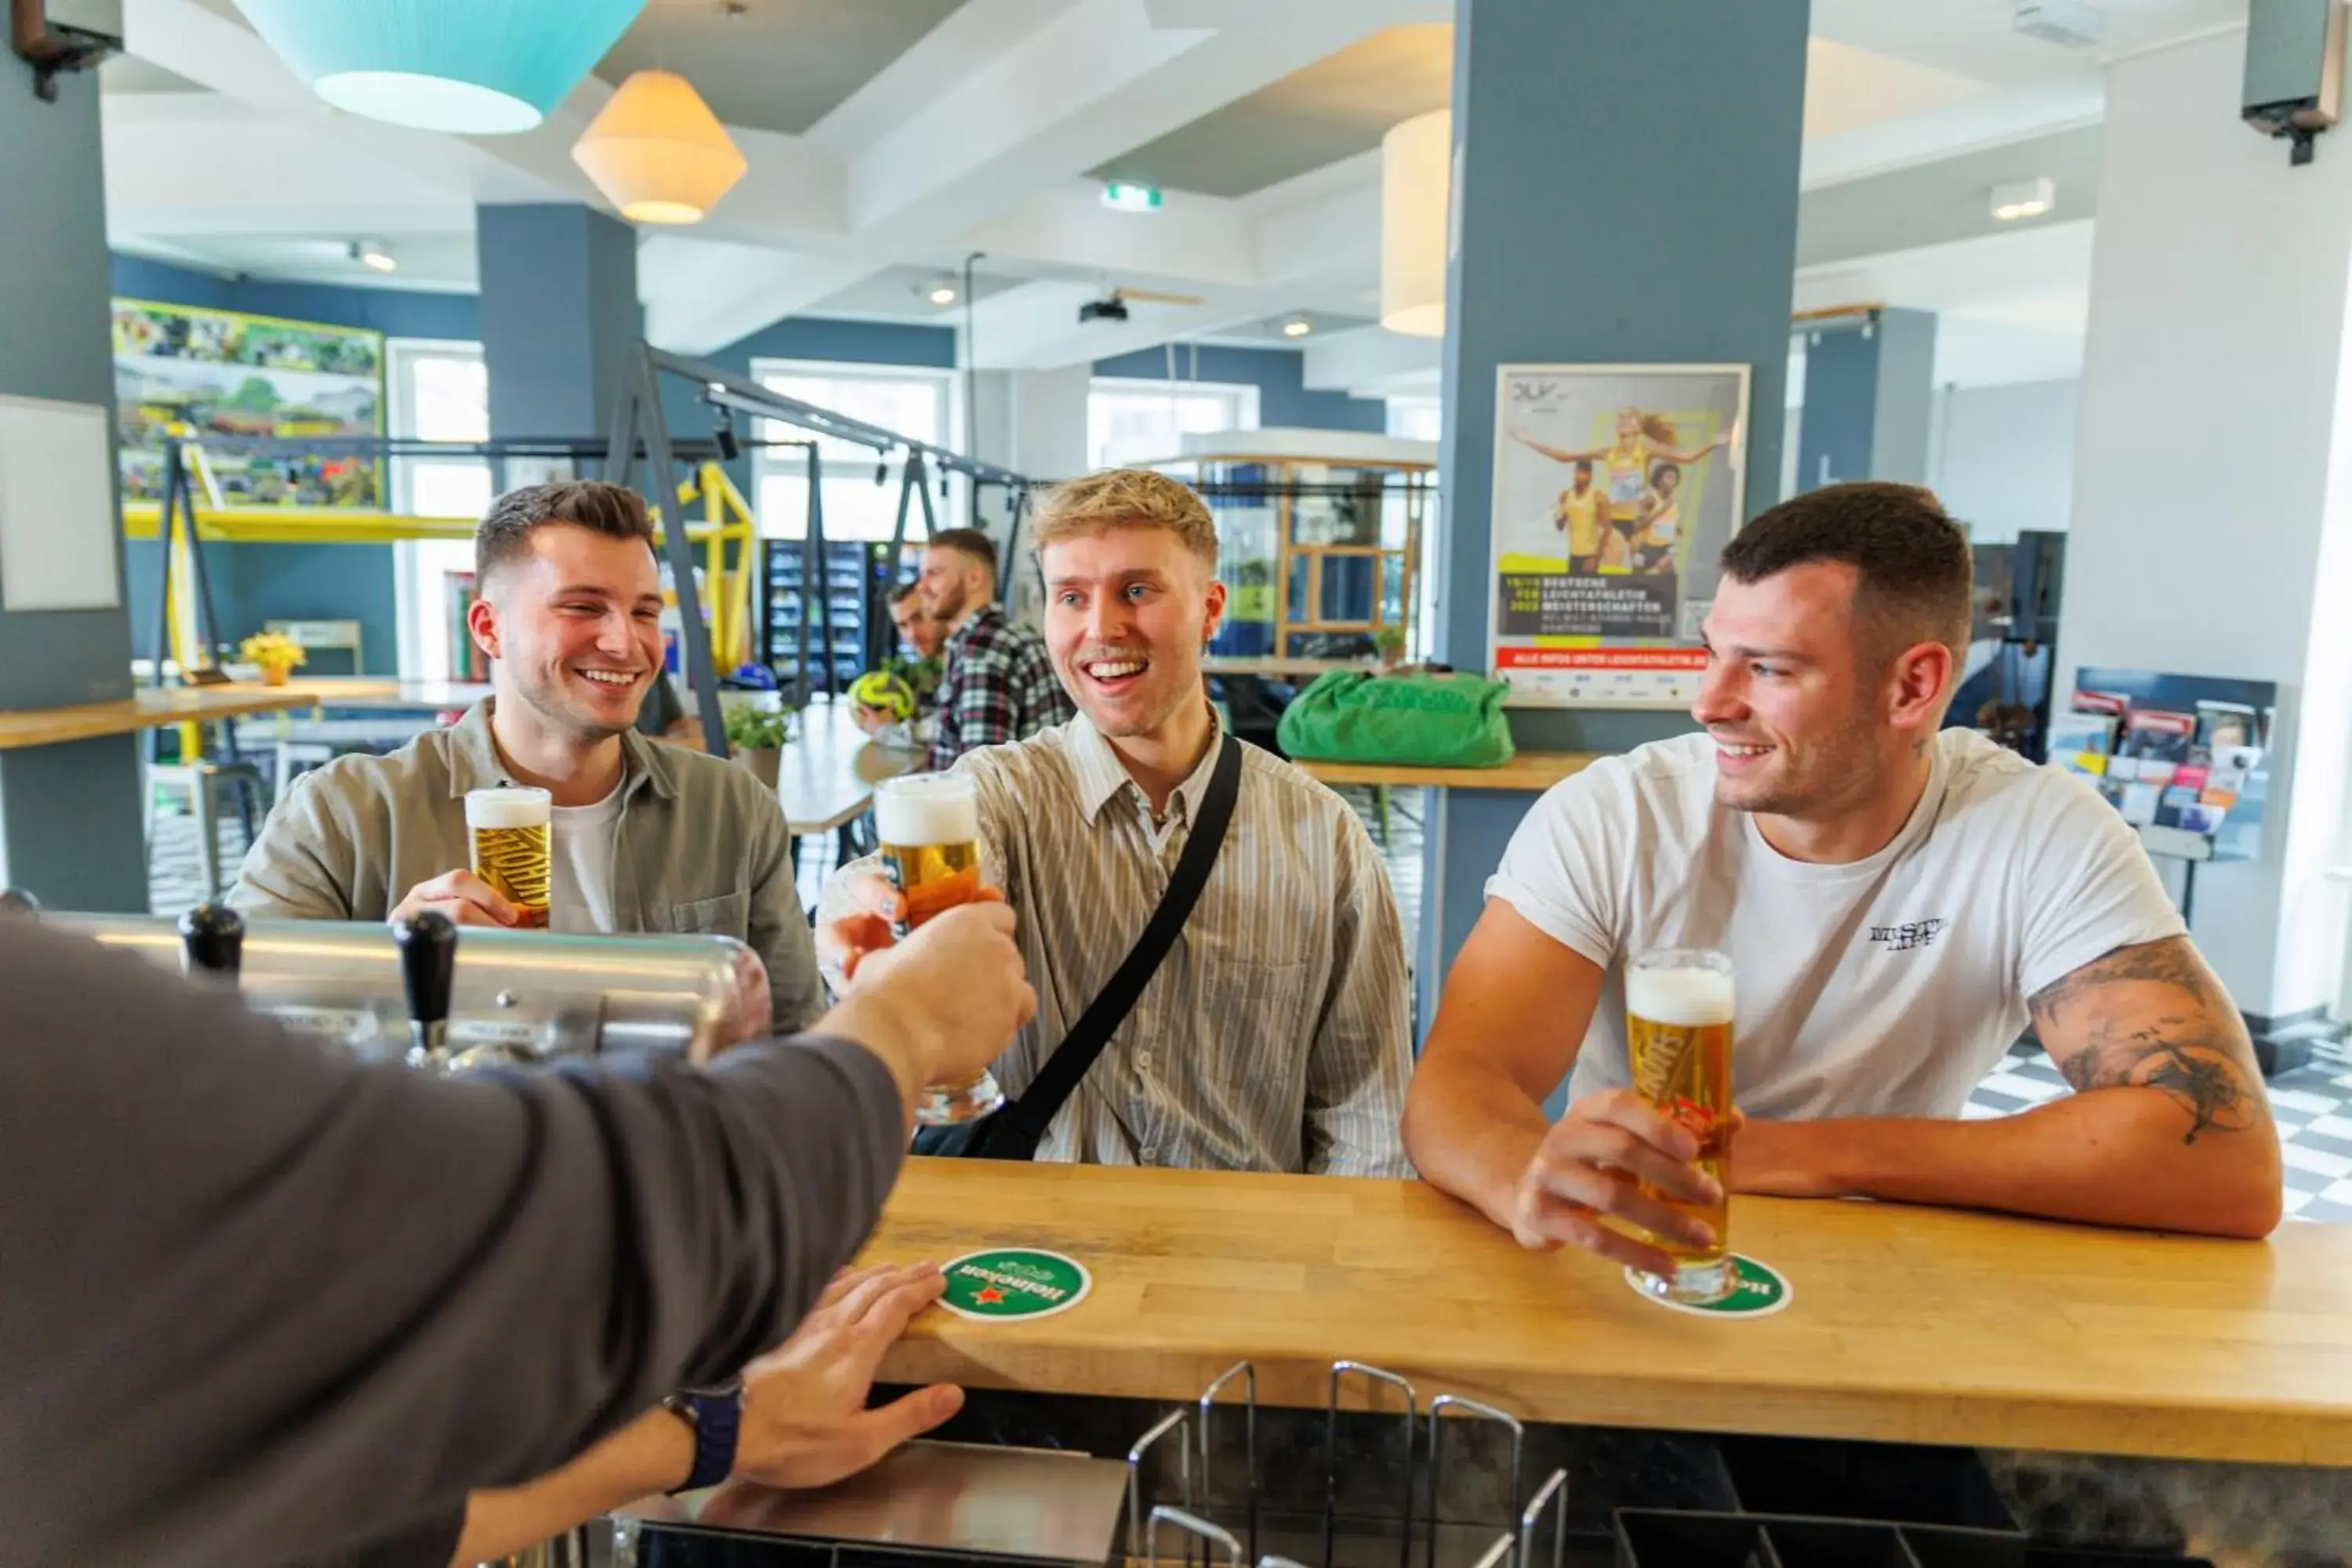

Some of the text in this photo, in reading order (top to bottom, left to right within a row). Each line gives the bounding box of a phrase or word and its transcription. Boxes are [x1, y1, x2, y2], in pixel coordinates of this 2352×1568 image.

[1542, 577, 1606, 588] DEUTSCHE
[1542, 590, 1646, 600] LEICHTATHLETIK
[1542, 601, 1661, 612] MEISTERSCHAFTEN
[1513, 652, 1538, 665] ALLE
[960, 1264, 1066, 1301] Heineken
